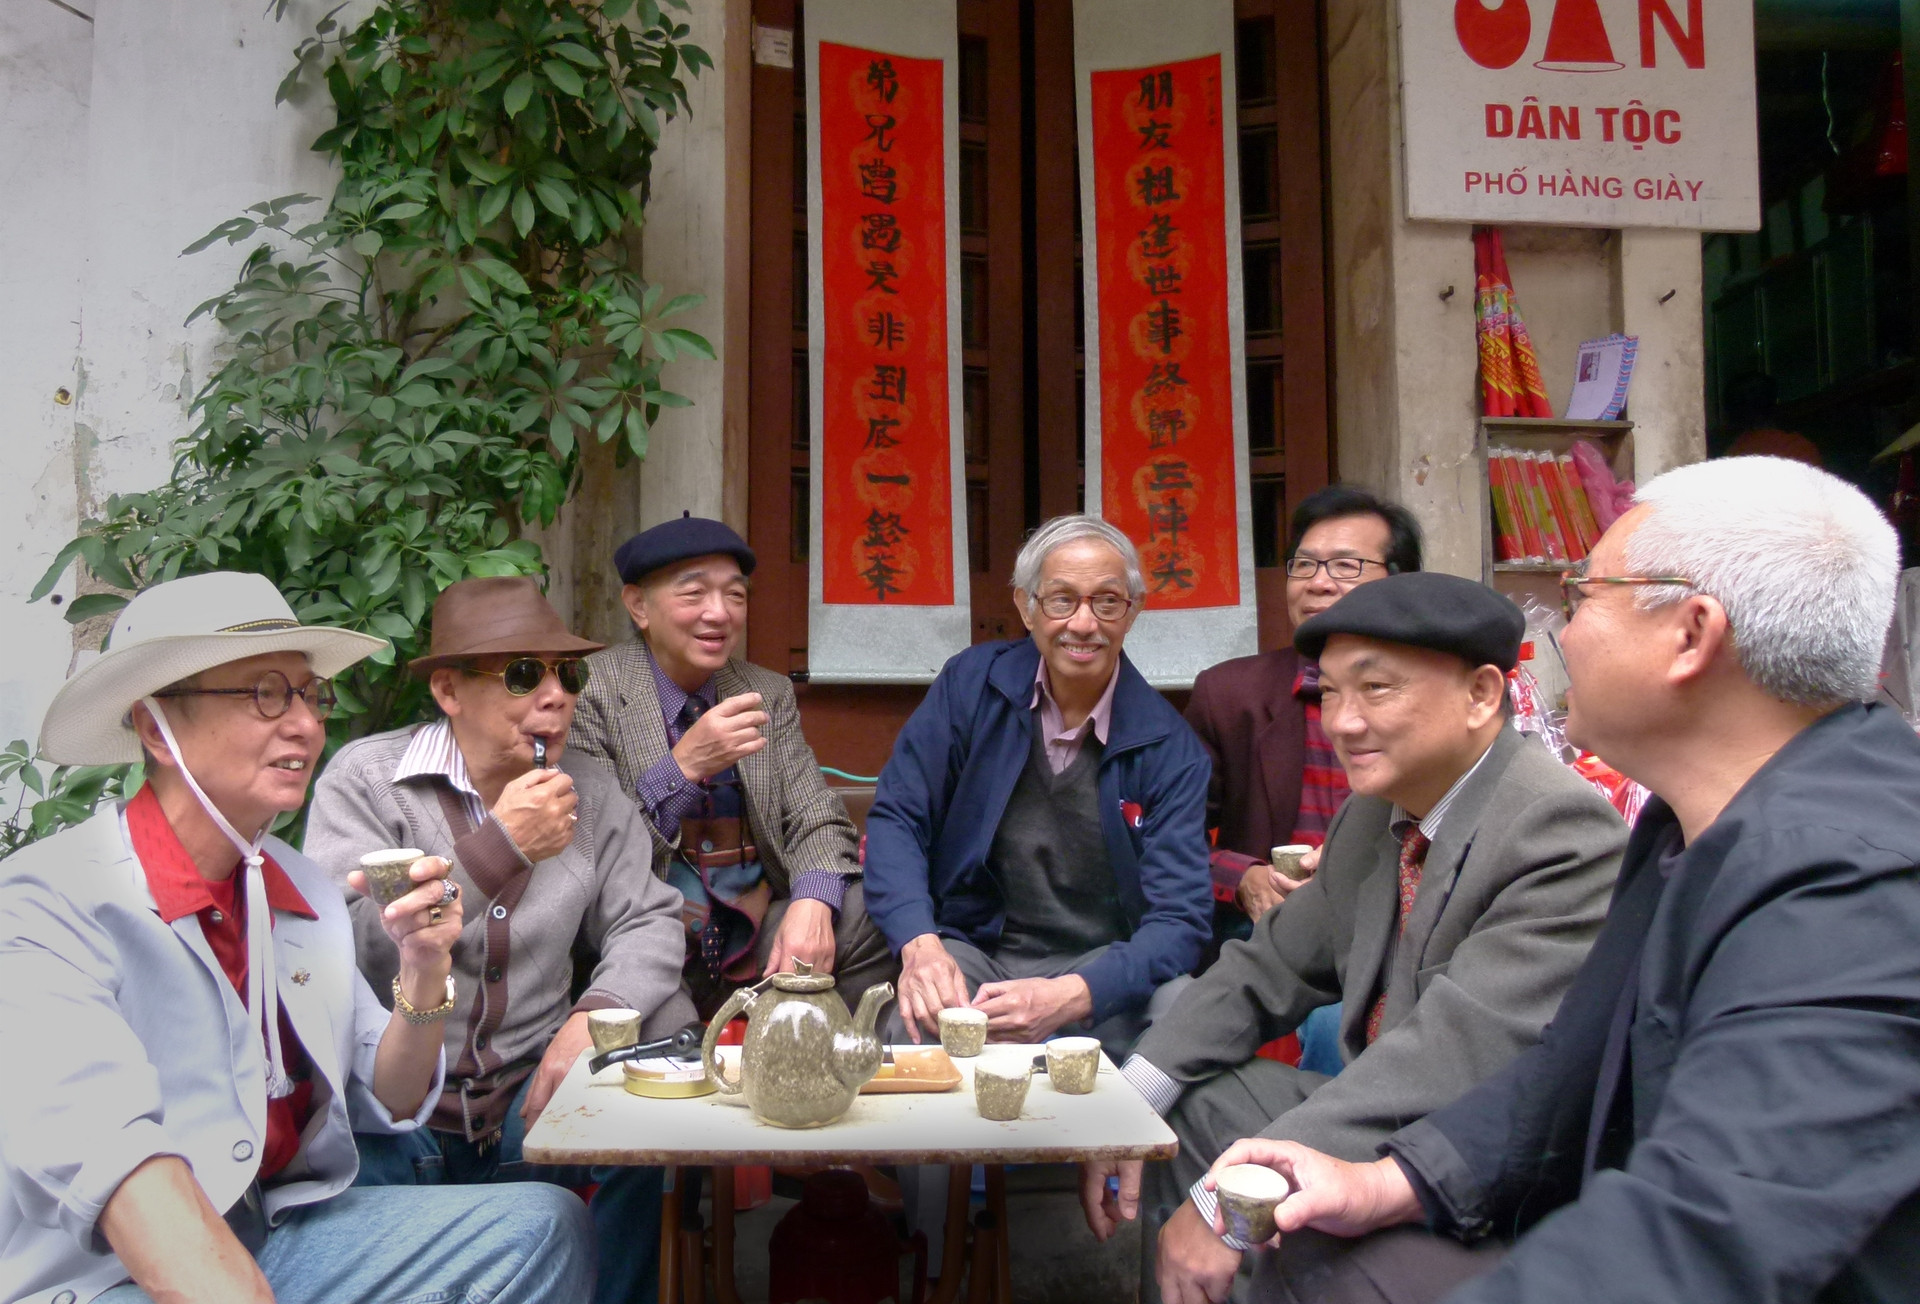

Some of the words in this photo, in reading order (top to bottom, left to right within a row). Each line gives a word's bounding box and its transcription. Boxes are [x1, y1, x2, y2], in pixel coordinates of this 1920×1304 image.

[1484, 96, 1581, 140] DÂN
[1594, 100, 1682, 151] TỘC
[1464, 166, 1528, 196] PHỐ
[1537, 169, 1623, 199] HÀNG
[1633, 173, 1704, 202] GIÀY
